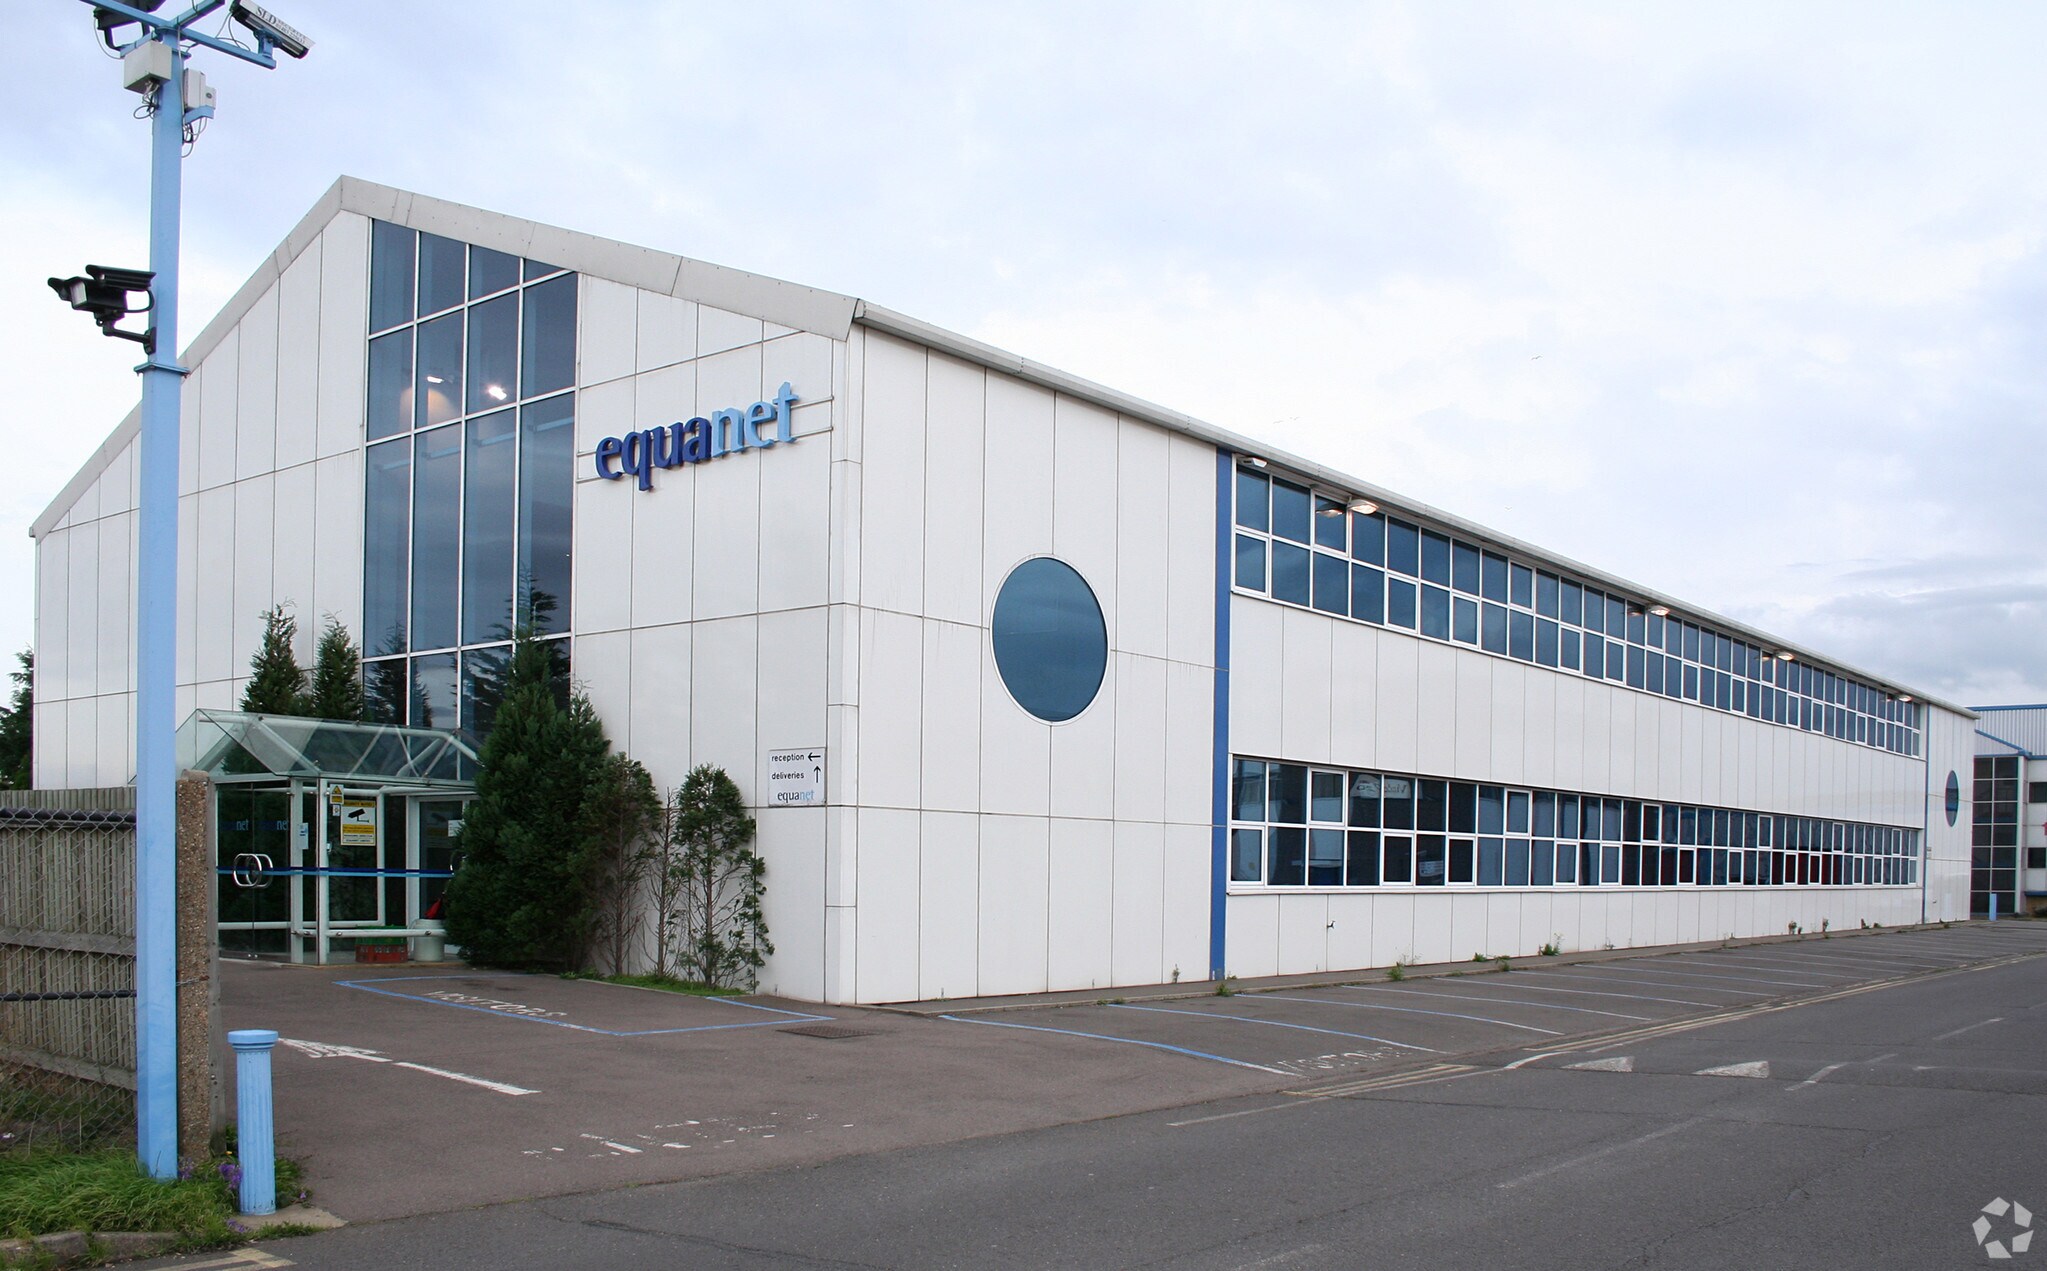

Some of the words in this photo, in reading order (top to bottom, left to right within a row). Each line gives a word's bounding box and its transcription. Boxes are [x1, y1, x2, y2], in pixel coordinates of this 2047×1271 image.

[595, 381, 799, 491] equanet
[771, 752, 805, 763] reception
[771, 771, 805, 780] deliveries
[777, 789, 815, 804] equanet
